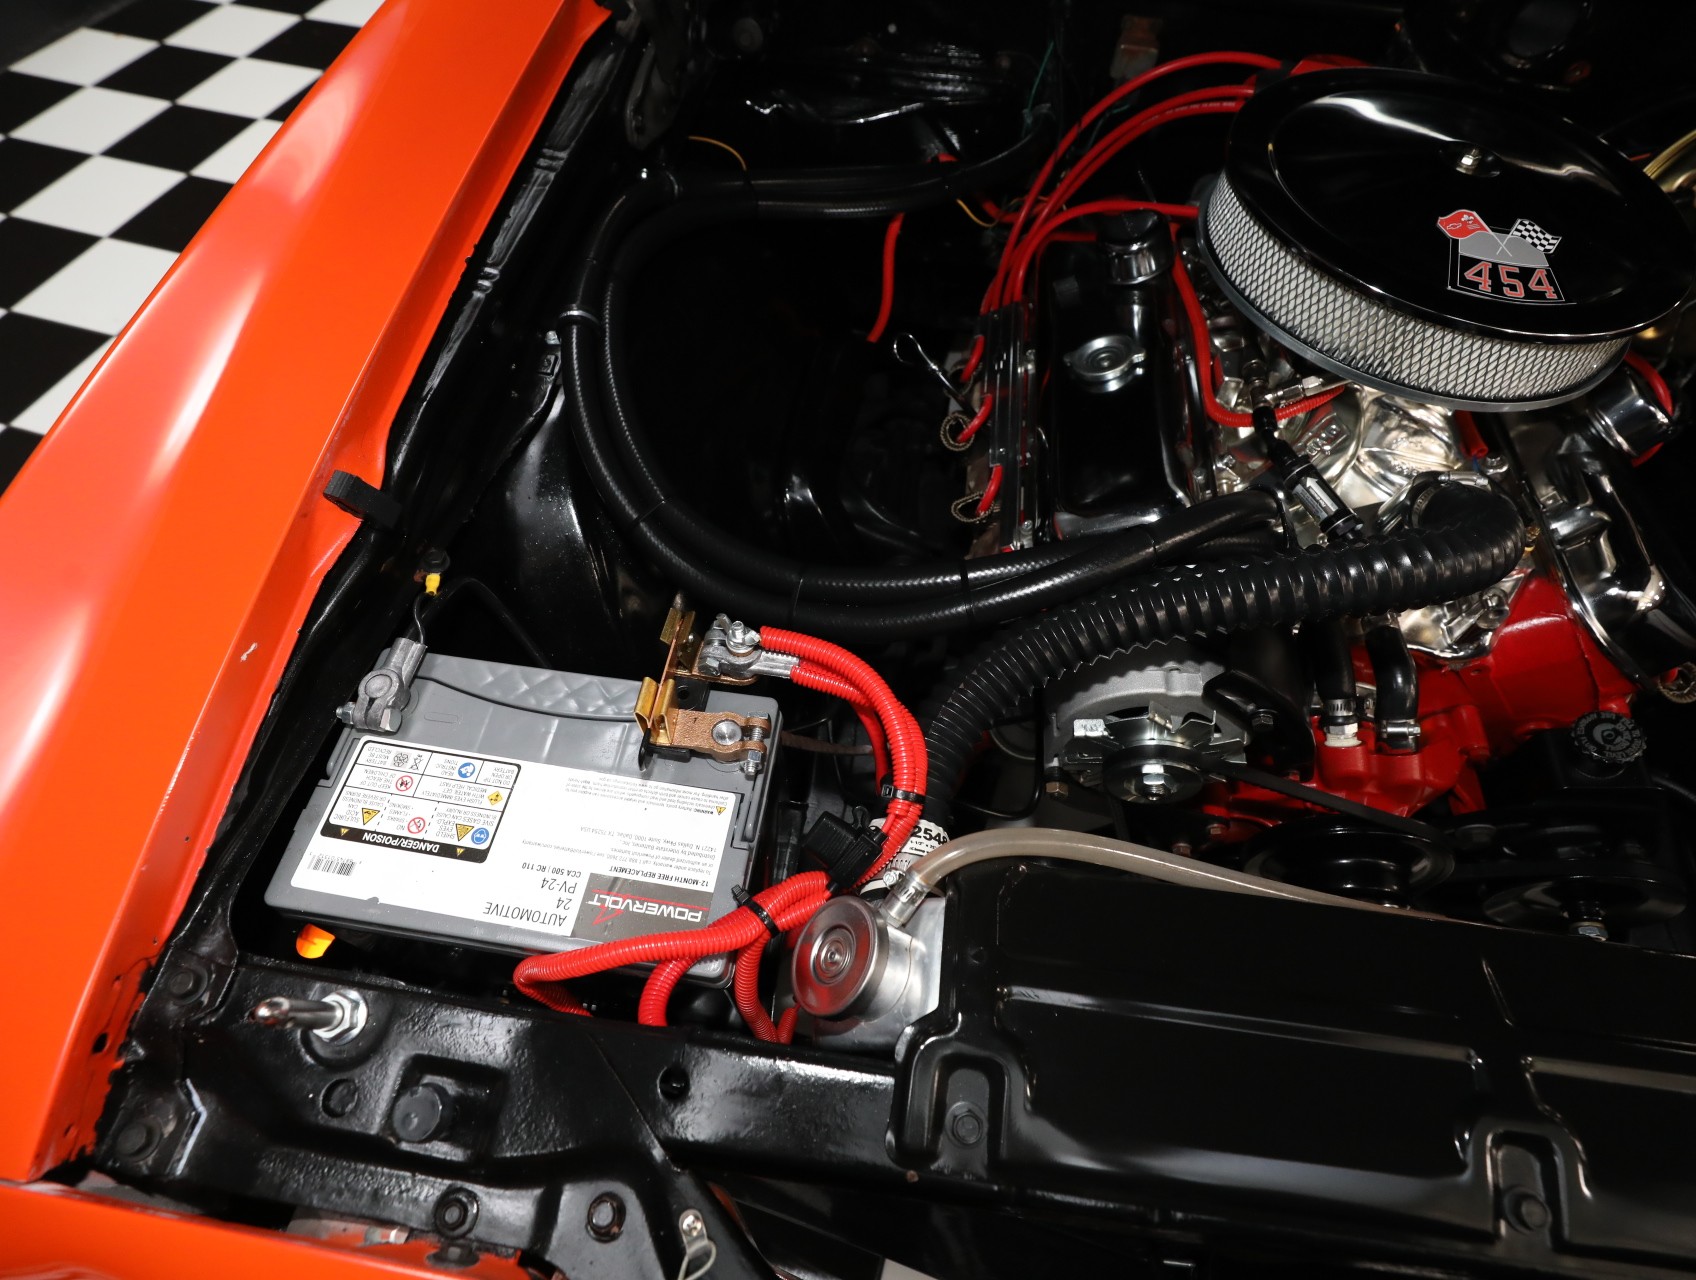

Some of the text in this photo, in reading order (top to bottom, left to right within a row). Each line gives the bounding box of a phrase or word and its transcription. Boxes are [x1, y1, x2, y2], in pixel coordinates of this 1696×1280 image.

[1464, 261, 1557, 298] 454
[421, 790, 453, 799] IMMEDIATELY
[341, 796, 368, 804] BLINDNESS
[332, 813, 360, 823] SULFURIC
[462, 815, 481, 823] GASES
[469, 811, 497, 819] BLINDNESS
[434, 830, 455, 839] SHIELD
[361, 832, 439, 852] DANGER/POISON
[655, 845, 679, 854] Interstate
[687, 850, 715, 860] Distributed
[521, 862, 534, 870] 110
[535, 864, 546, 872] RC
[551, 867, 564, 875] 500
[565, 869, 581, 878] CCA
[609, 865, 709, 886] 12-MONTH FREE REPLACEMENT
[540, 877, 577, 893] PV-24
[555, 897, 572, 910] 24
[587, 893, 702, 922] POWERVOLT
[482, 901, 567, 926] AUTOMOTIVE
